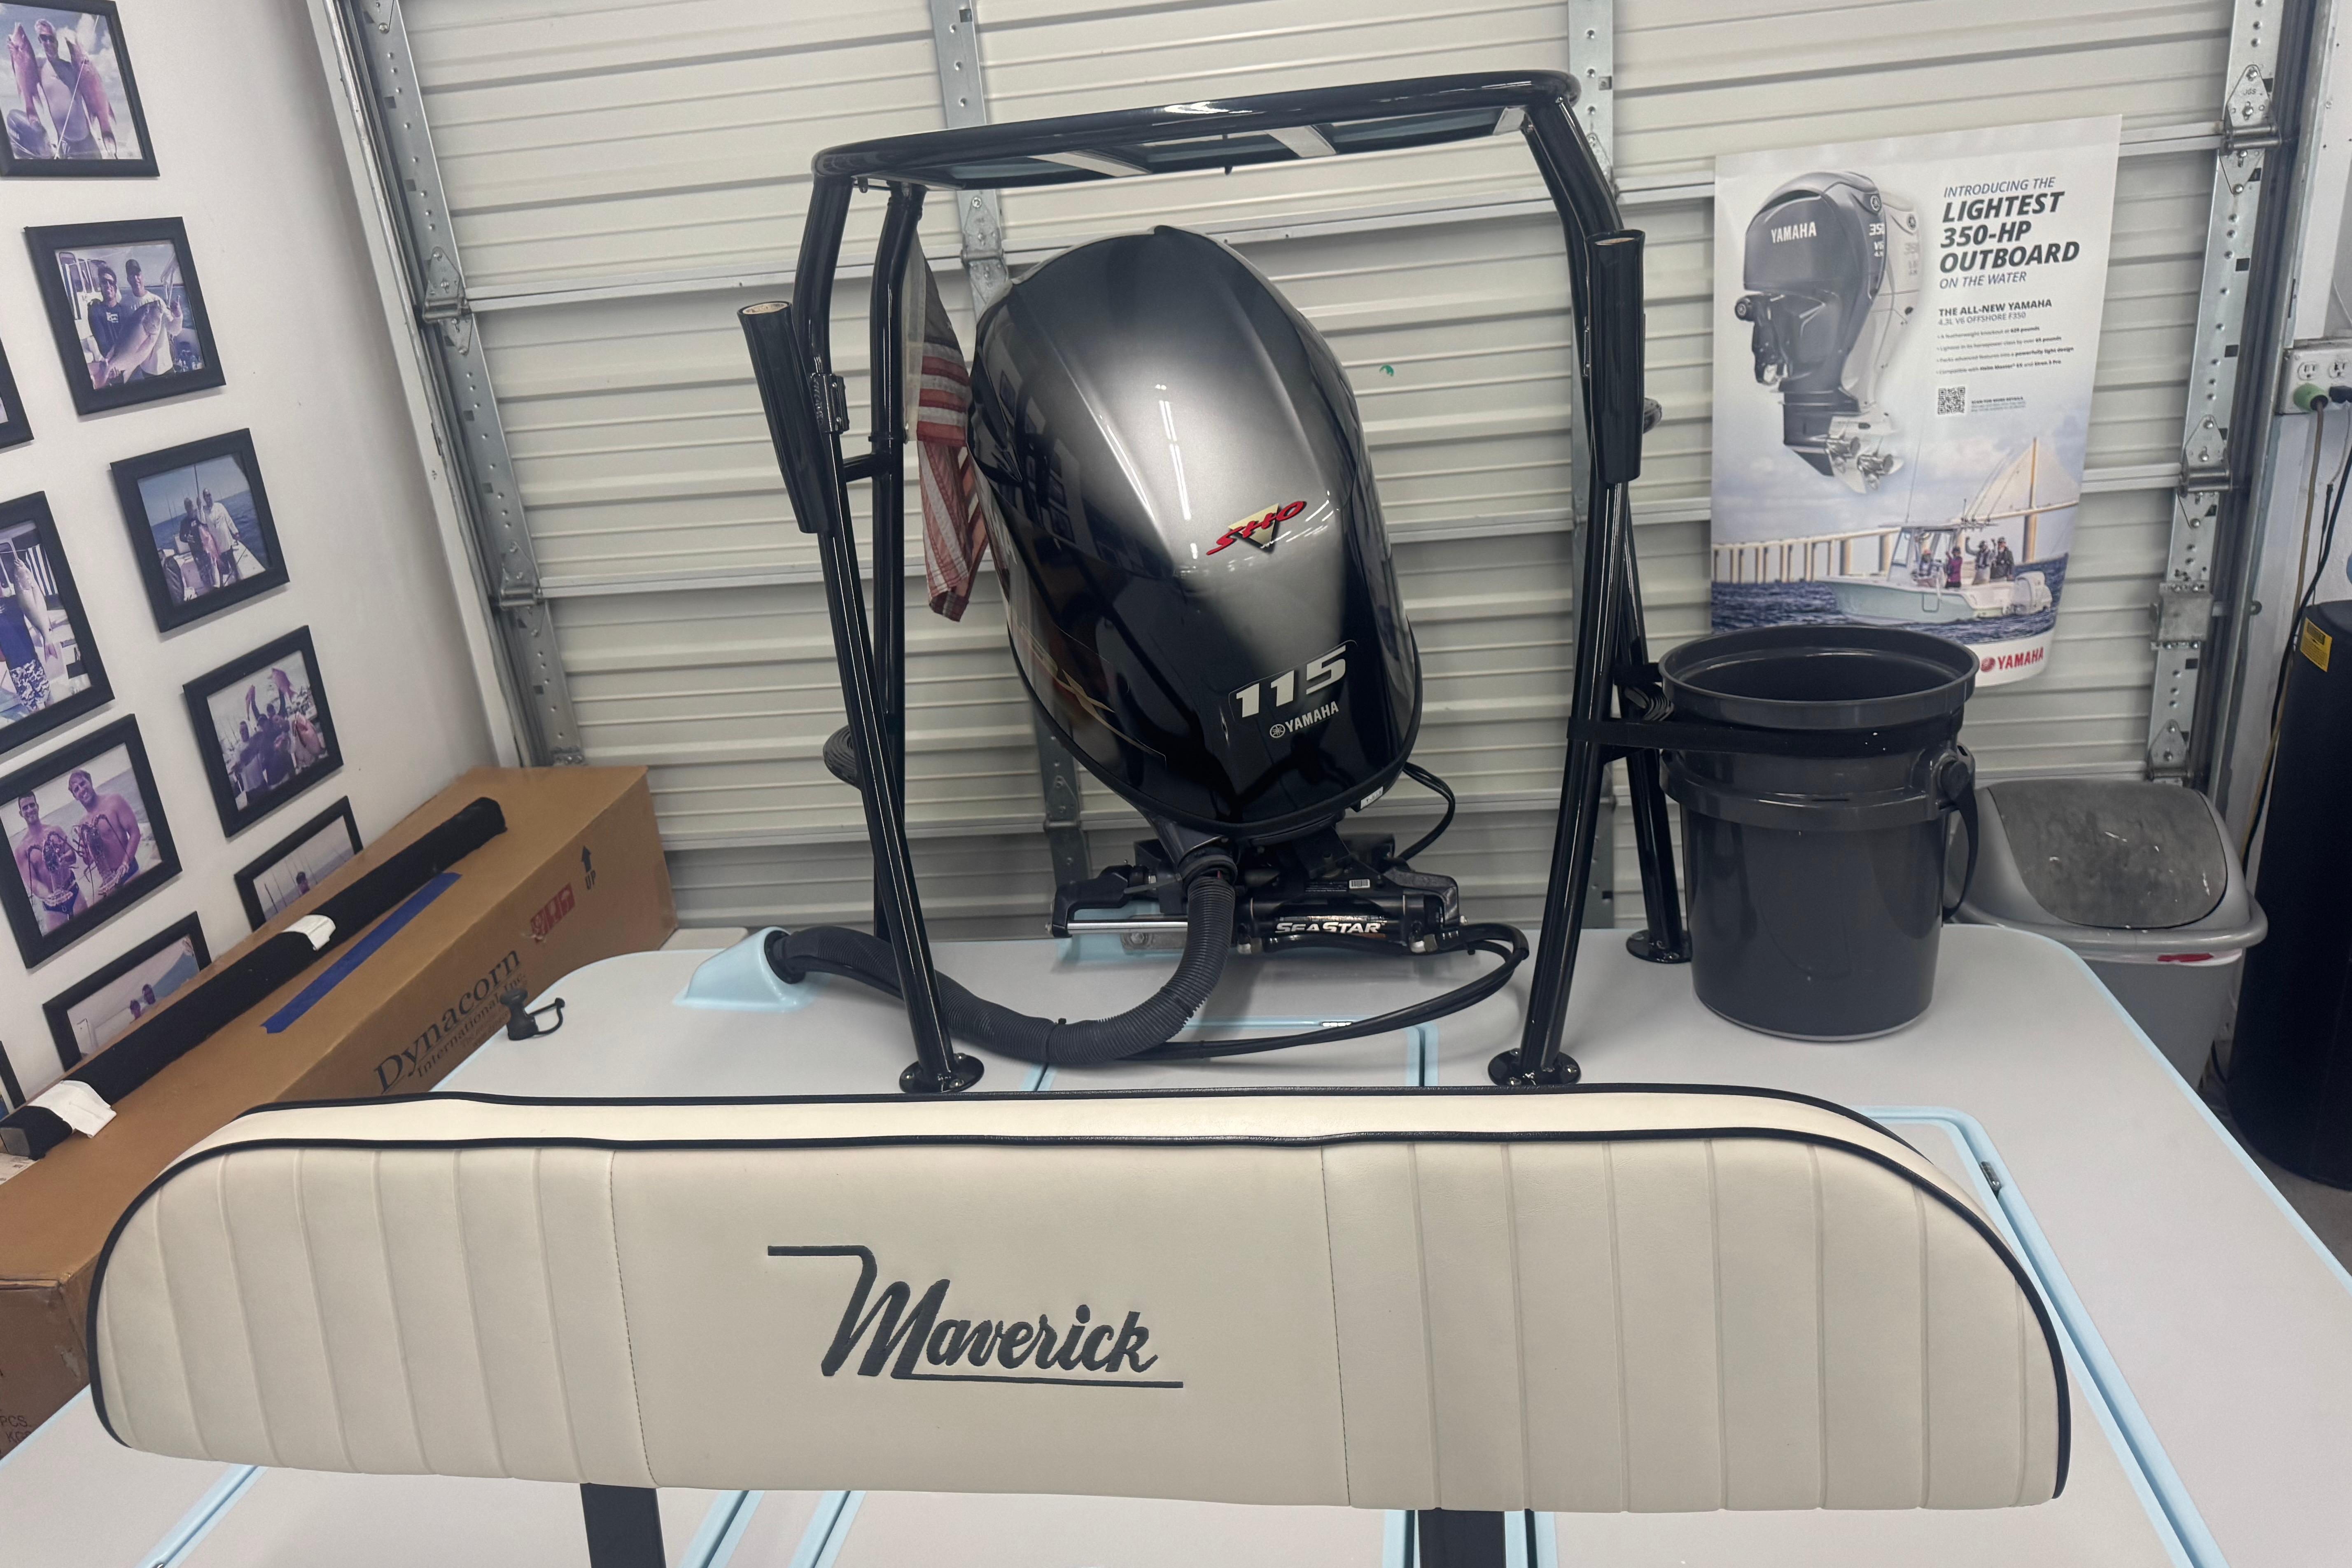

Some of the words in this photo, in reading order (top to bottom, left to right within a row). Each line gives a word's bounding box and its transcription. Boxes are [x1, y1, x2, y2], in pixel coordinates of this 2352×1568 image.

[1944, 179, 2029, 198] INTRODUCING
[2033, 177, 2056, 189] THE
[1942, 191, 2065, 223] LIGHTEST
[1771, 221, 1817, 243] YAMAHA
[1940, 221, 2032, 248] 350-HP
[1940, 241, 2080, 273] OUTBOARD
[1939, 277, 1958, 289] ON
[1962, 275, 1985, 287] THE
[1988, 271, 2027, 285] WATER
[1939, 308, 1958, 317] THE
[1960, 303, 2006, 315] ALL-NEW
[2008, 299, 2052, 309] YAMAHA
[1967, 313, 2007, 323] OFFSHORE
[2008, 311, 2026, 320] F350
[1206, 501, 1306, 555] SHO
[1998, 646, 2044, 670] YAMAHA
[1236, 645, 1346, 718] 115
[1285, 701, 1339, 733] YAMAHA
[585, 870, 596, 890] UP
[373, 950, 520, 1095] Dynacorn
[418, 992, 501, 1078] International
[768, 1246, 1183, 1388] Maverick
